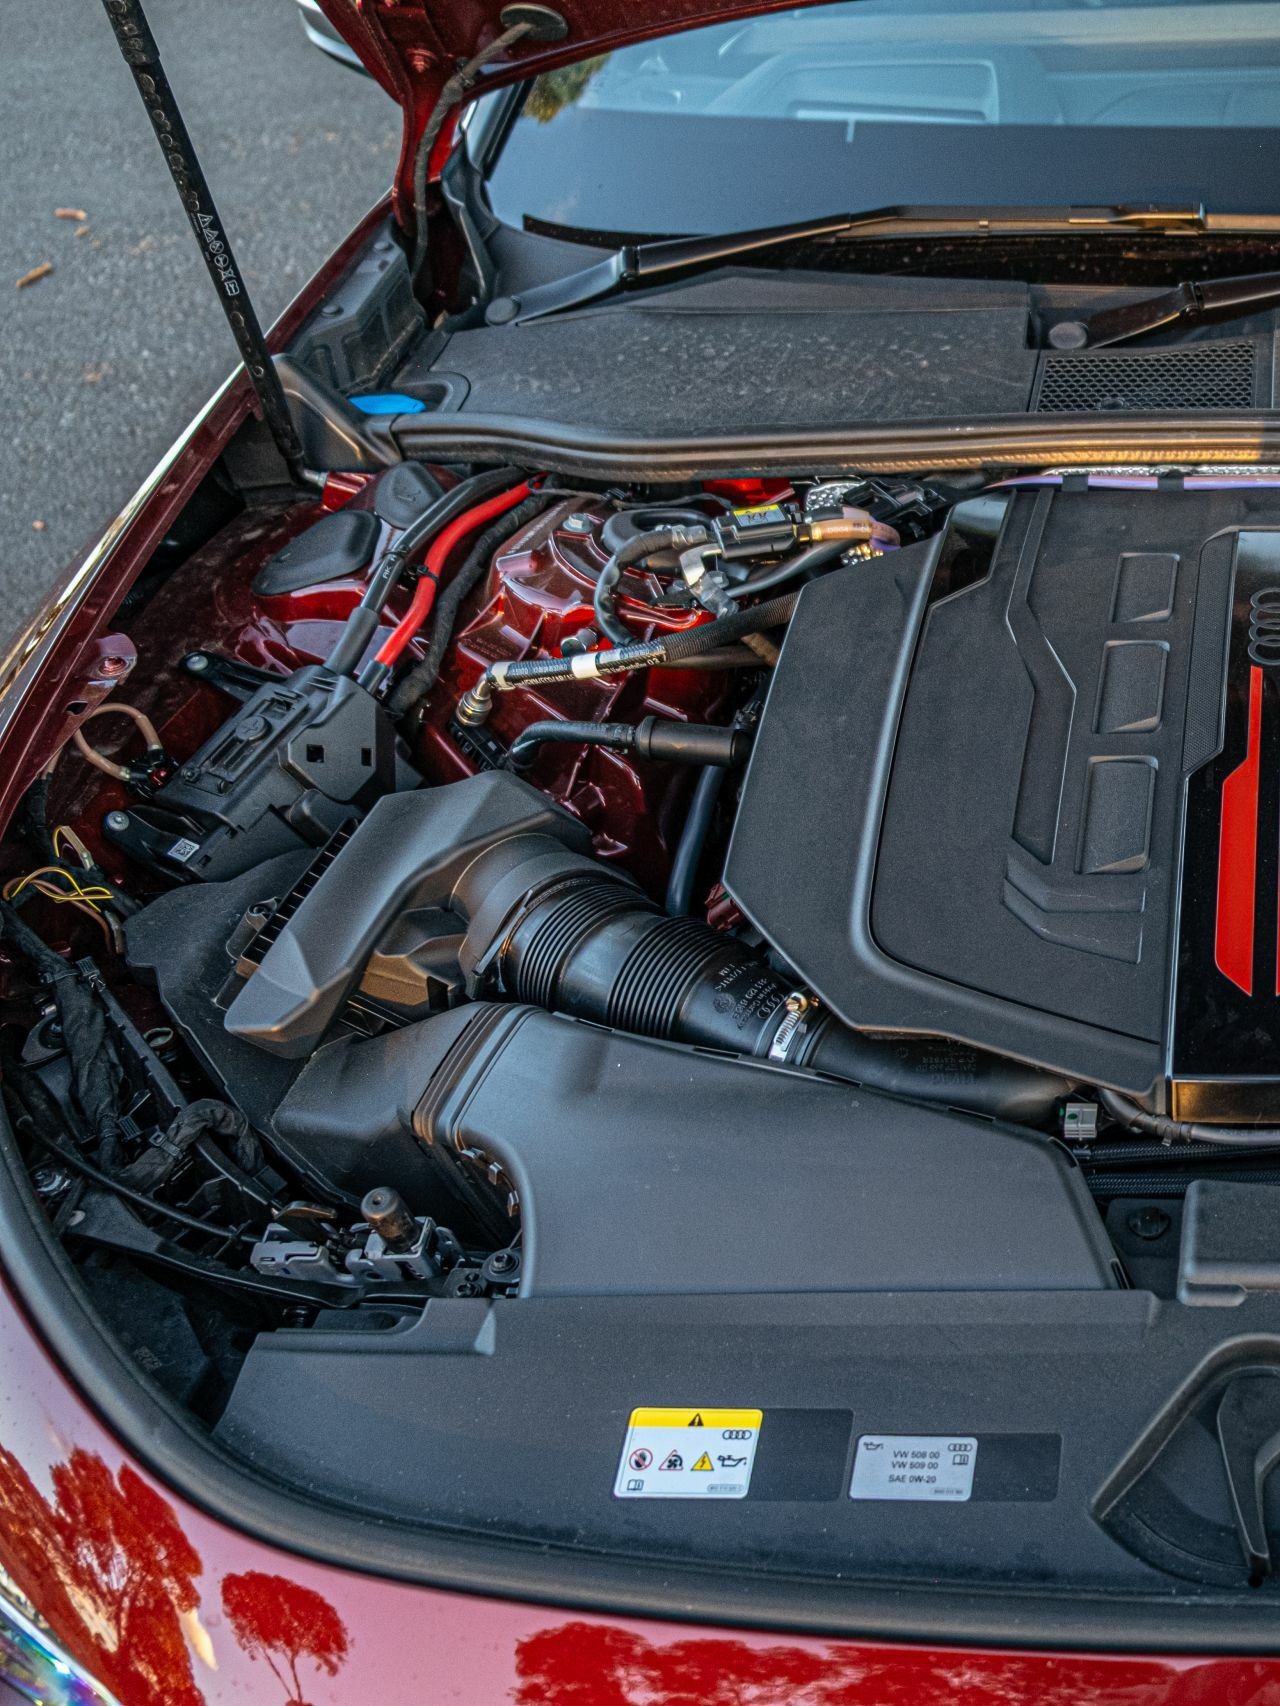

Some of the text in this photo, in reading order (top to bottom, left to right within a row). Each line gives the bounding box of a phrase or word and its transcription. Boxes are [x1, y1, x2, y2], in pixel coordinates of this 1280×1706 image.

[893, 1450, 940, 1460] VW 508 00
[891, 1460, 939, 1470] VW 509 00
[888, 1474, 937, 1484] SAE 0W-20
